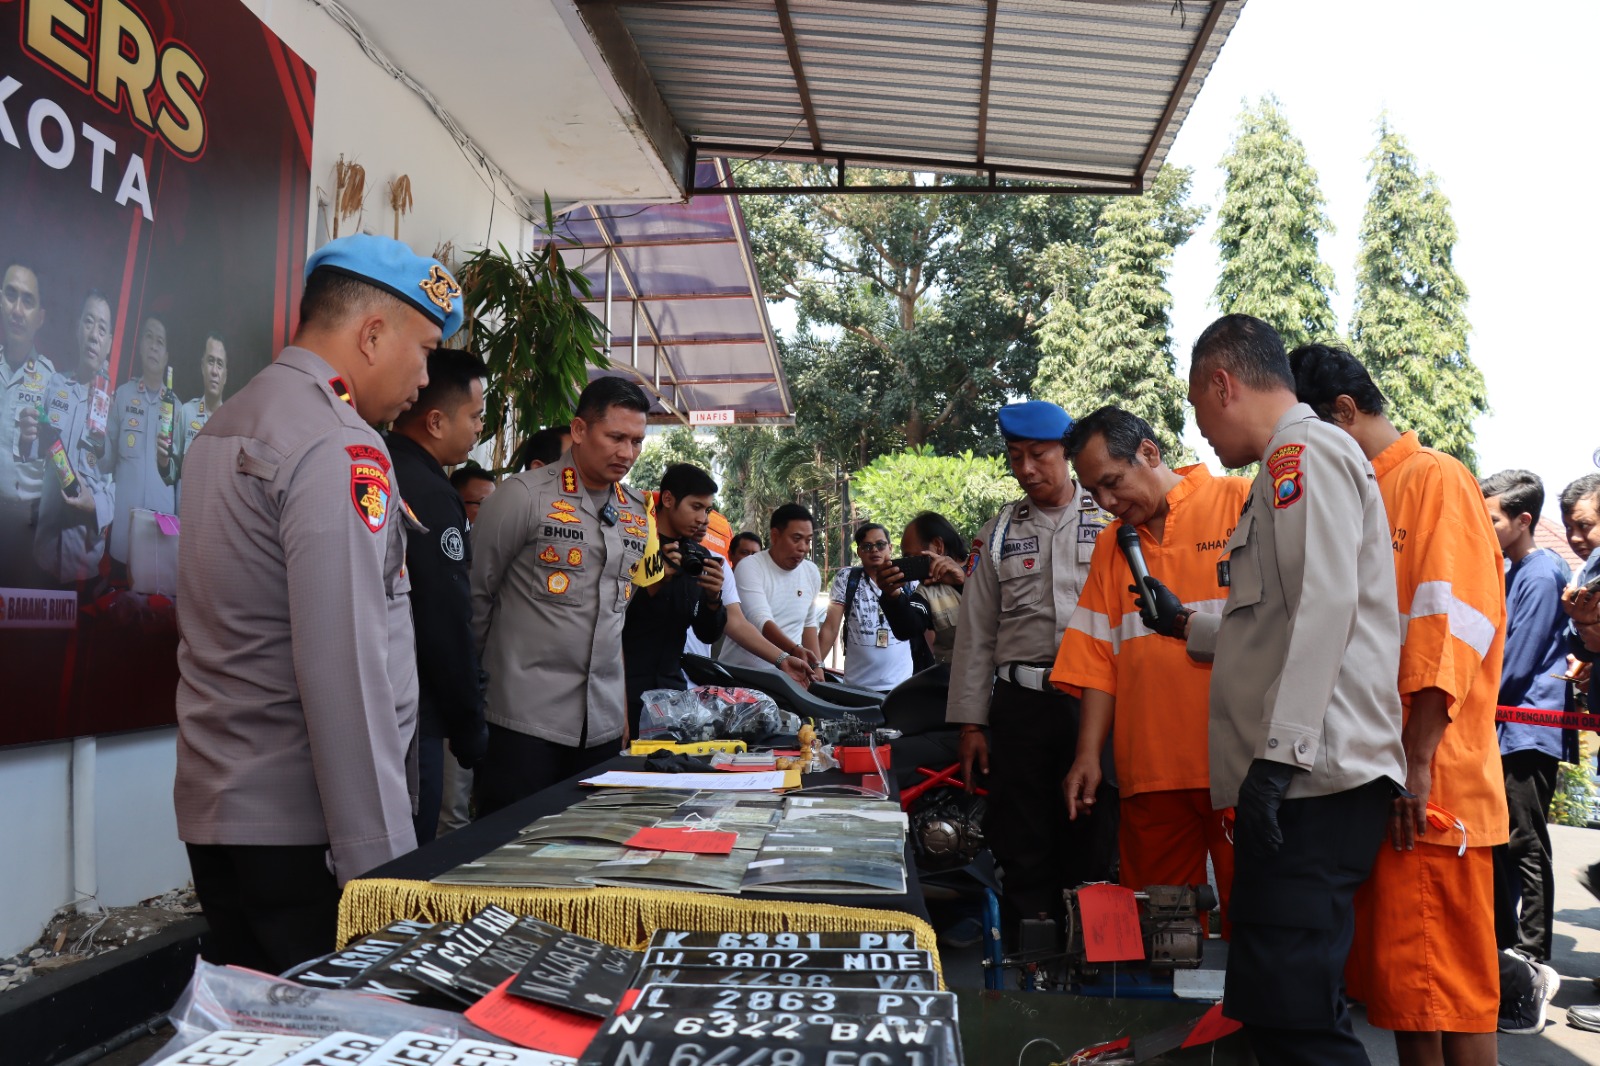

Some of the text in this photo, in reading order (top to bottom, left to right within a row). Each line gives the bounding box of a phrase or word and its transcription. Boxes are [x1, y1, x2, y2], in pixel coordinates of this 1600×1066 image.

[696, 413, 728, 421] INAFIS
[544, 526, 584, 540] BHUDI
[8, 597, 76, 621] BARANG BUKTI
[1515, 711, 1579, 726] PENGAMANAN
[662, 931, 911, 950] K 6391 PK
[328, 938, 404, 969] 6391
[706, 951, 810, 969] 3802
[843, 953, 922, 971] NDE
[531, 950, 591, 987] 6448
[361, 979, 420, 1001] K
[521, 980, 572, 1000] N
[647, 988, 936, 1016] L 2863 PY
[608, 1013, 645, 1035] N
[673, 1016, 803, 1040] 6344
[830, 1021, 929, 1045] BAW
